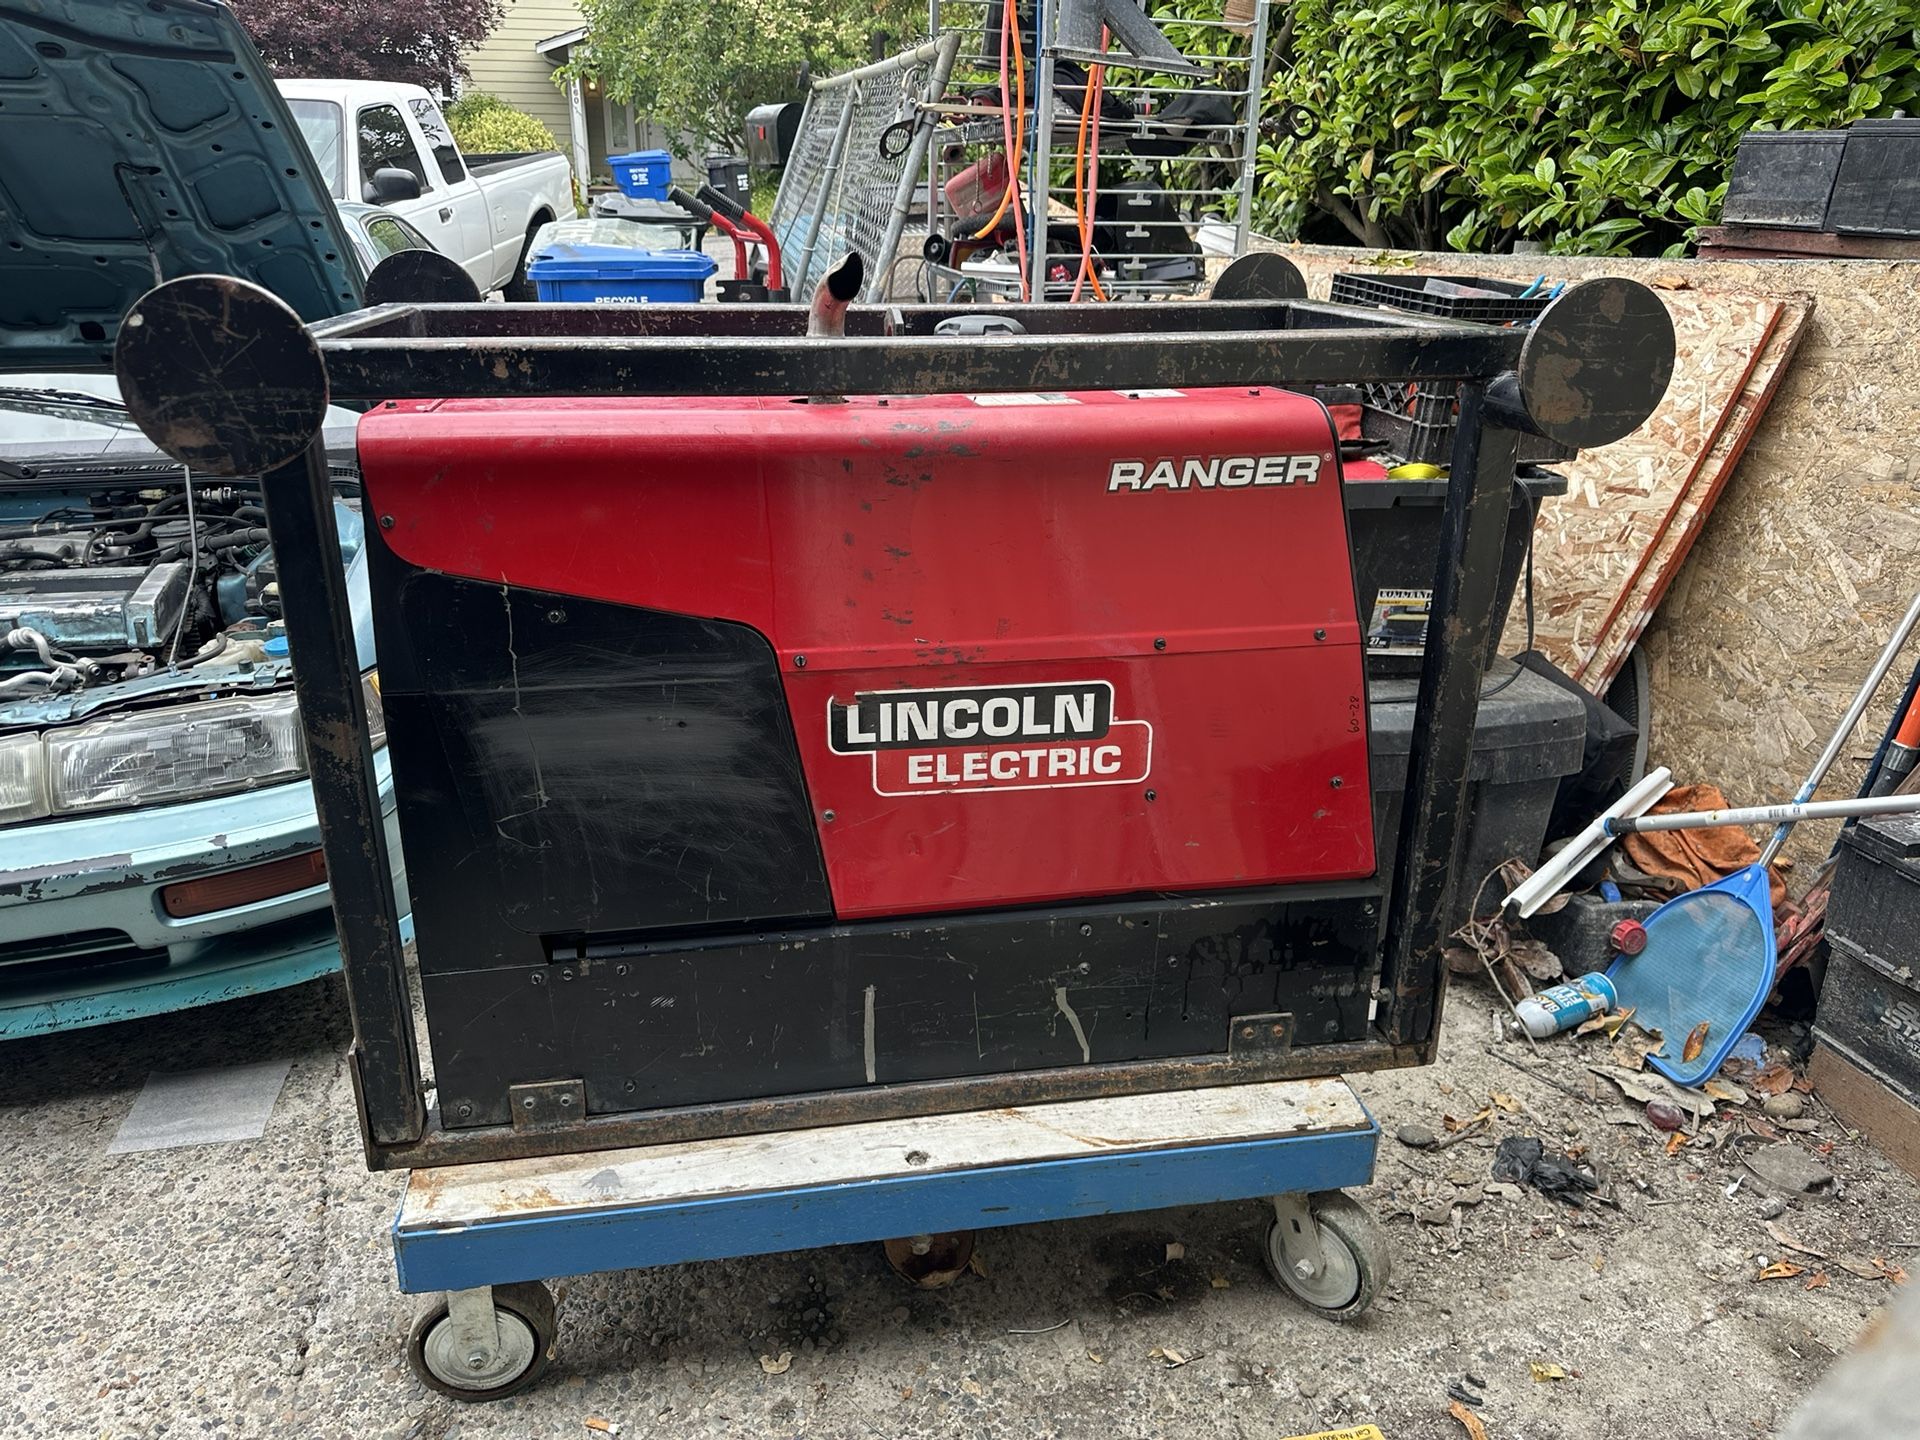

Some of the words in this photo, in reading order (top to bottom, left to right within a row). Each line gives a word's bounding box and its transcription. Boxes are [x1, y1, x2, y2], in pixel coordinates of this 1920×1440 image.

[594, 296, 649, 304] RECYCLE
[1108, 455, 1321, 491] RANGER
[847, 693, 1096, 744] LINCOLN
[908, 745, 1122, 784] ELECTRIC
